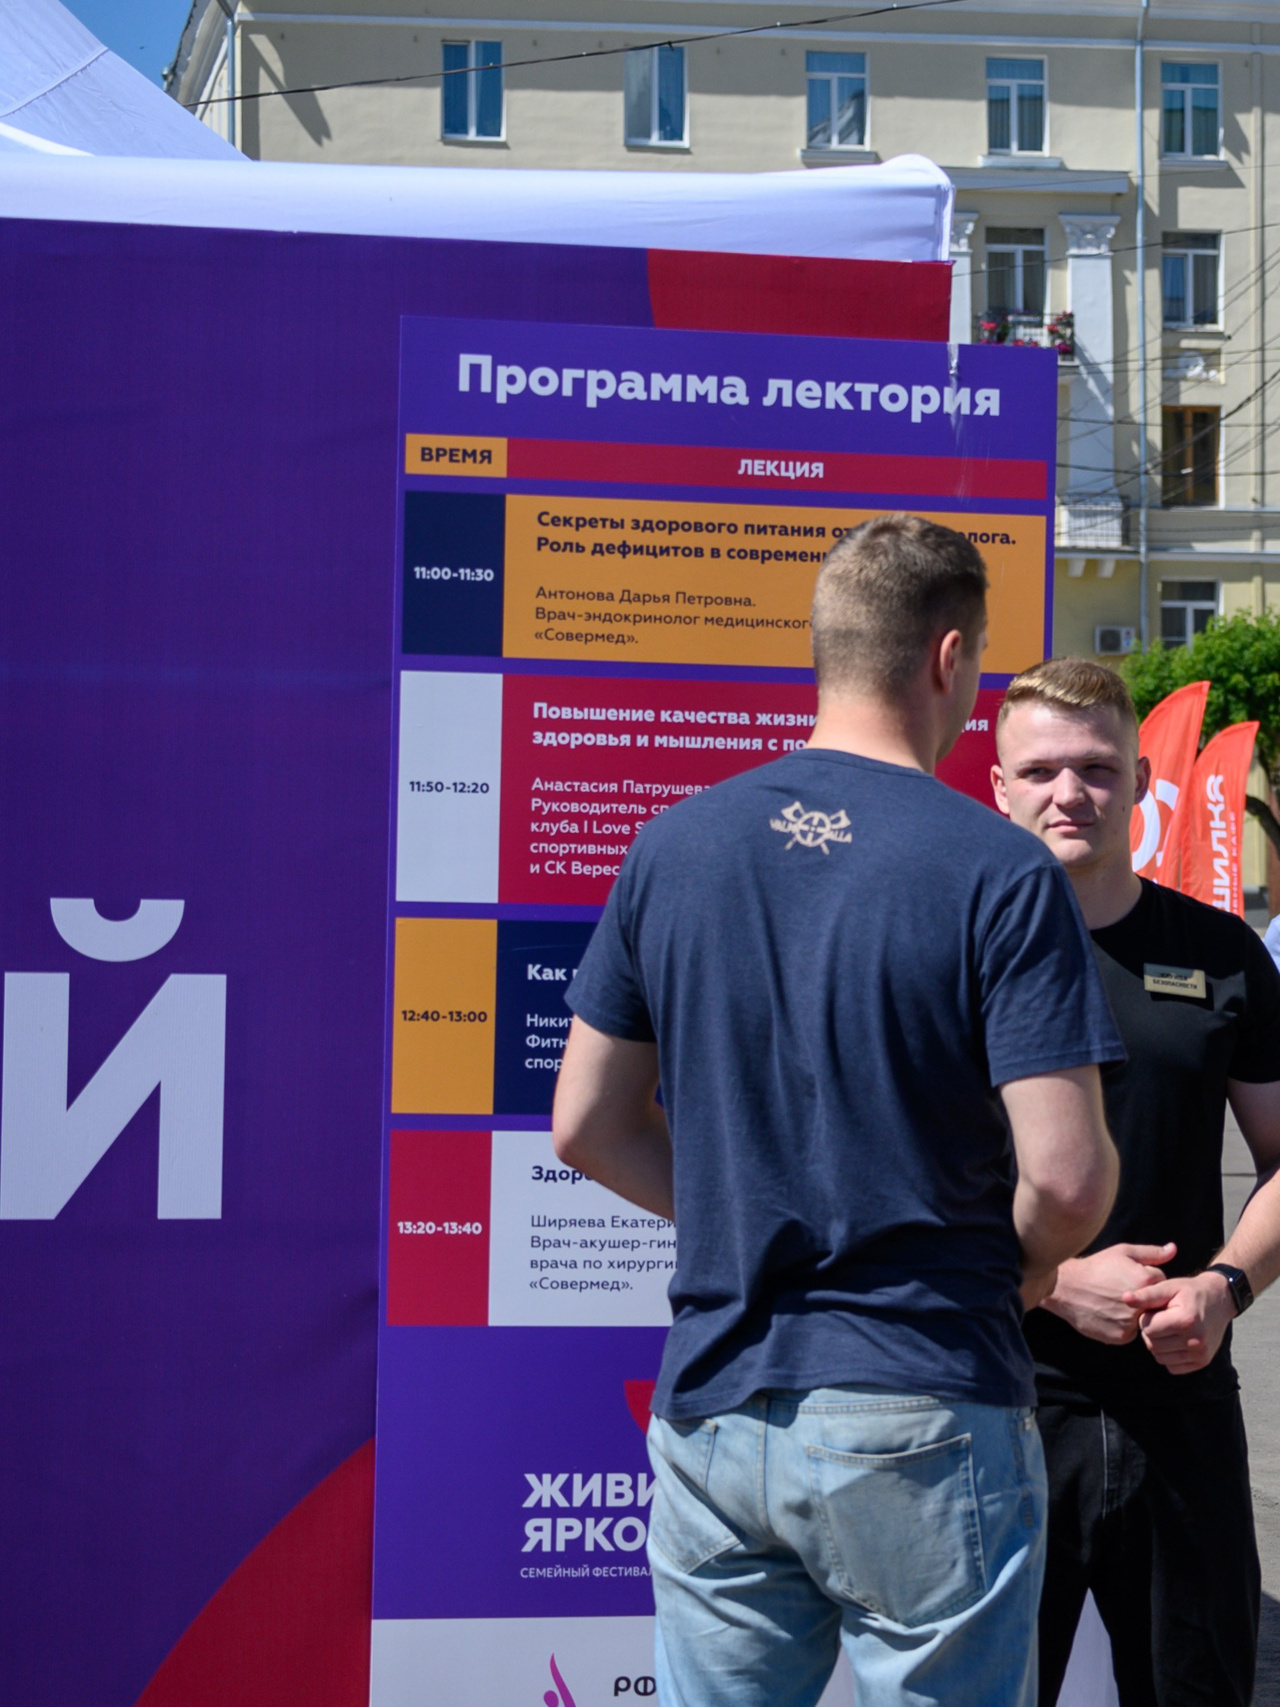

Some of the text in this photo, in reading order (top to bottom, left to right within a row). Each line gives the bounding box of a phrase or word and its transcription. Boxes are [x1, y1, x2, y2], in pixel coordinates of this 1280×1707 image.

[458, 353, 1001, 422] Программа лектория
[420, 446, 493, 465] ВРЕМЯ
[737, 458, 824, 480] ЛЕКЦИЯ
[536, 510, 626, 532] Секреты
[630, 517, 738, 537] здорового
[743, 522, 826, 539] питания
[536, 536, 586, 554] Роль
[590, 539, 705, 560] дефицитов
[710, 546, 721, 559] в
[413, 566, 495, 582] 11:00-11:30
[535, 586, 757, 608] Антонова Дарья Петровна.
[535, 606, 701, 626] Врач-эндокринолог
[534, 627, 639, 645] «Совермед».
[533, 701, 656, 723] Повышение
[660, 709, 751, 726] качества
[962, 717, 989, 734] ия
[532, 731, 632, 750] здоровья
[636, 734, 650, 748] и
[654, 734, 763, 751] мышления
[767, 738, 778, 752] с
[408, 779, 491, 795] 11:50-12:20
[531, 777, 619, 794] Анастасия
[531, 797, 648, 816] Руководитель
[530, 819, 580, 837] клуба
[592, 820, 631, 835] Love
[529, 842, 629, 857] спортивных
[529, 863, 541, 875] и
[544, 860, 568, 875] СК
[527, 963, 568, 981] Как
[401, 1009, 488, 1025] 12:40-13:00
[397, 1220, 483, 1235] 13:20-13:40
[530, 1215, 606, 1231] Ширяева
[529, 1259, 578, 1272] врача
[582, 1259, 603, 1270] по
[529, 1276, 634, 1293] «Совермед».
[521, 1516, 648, 1552] ЯРКО
[520, 1563, 590, 1579] СЕМЕЙНЫЙ
